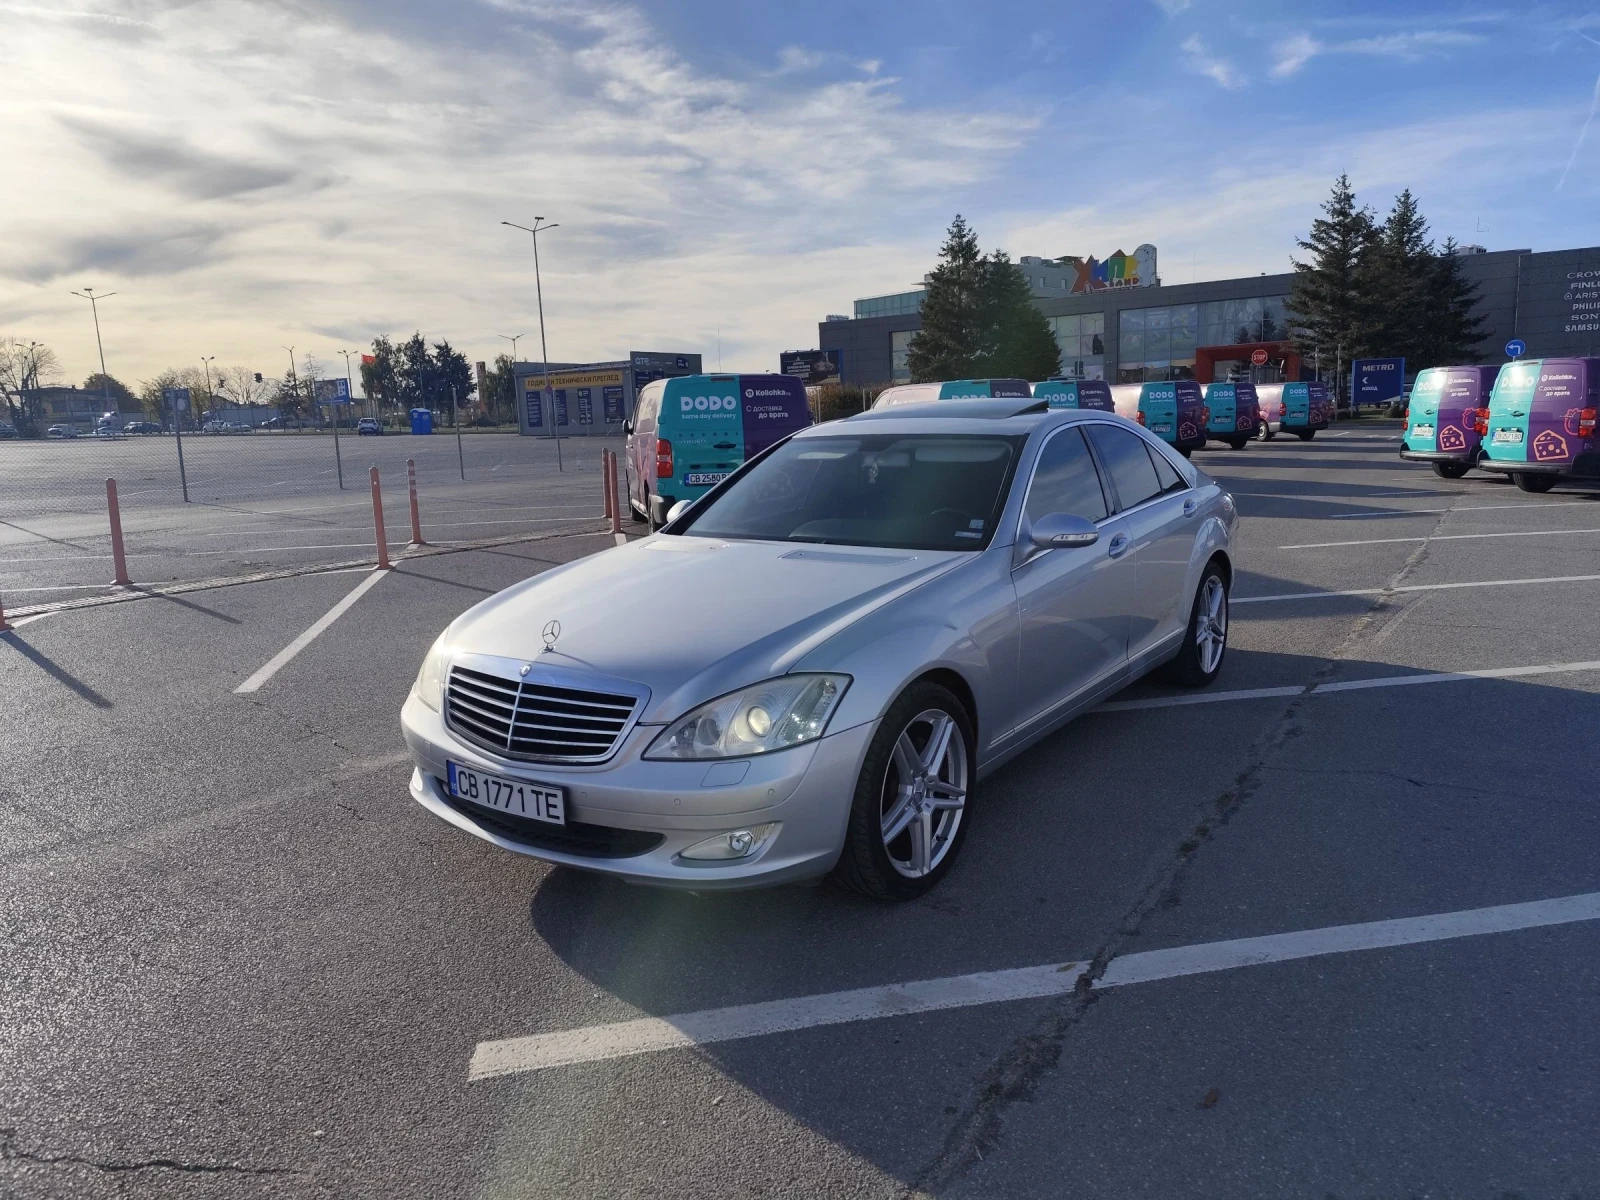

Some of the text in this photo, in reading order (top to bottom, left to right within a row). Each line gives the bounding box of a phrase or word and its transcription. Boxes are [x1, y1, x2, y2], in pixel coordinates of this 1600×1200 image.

[593, 374, 620, 382] ПРЕГЛЕД
[1149, 391, 1174, 399] DODO
[681, 396, 736, 411] DODO
[702, 474, 721, 482] 2580
[458, 771, 561, 820] CB 1771 TE
